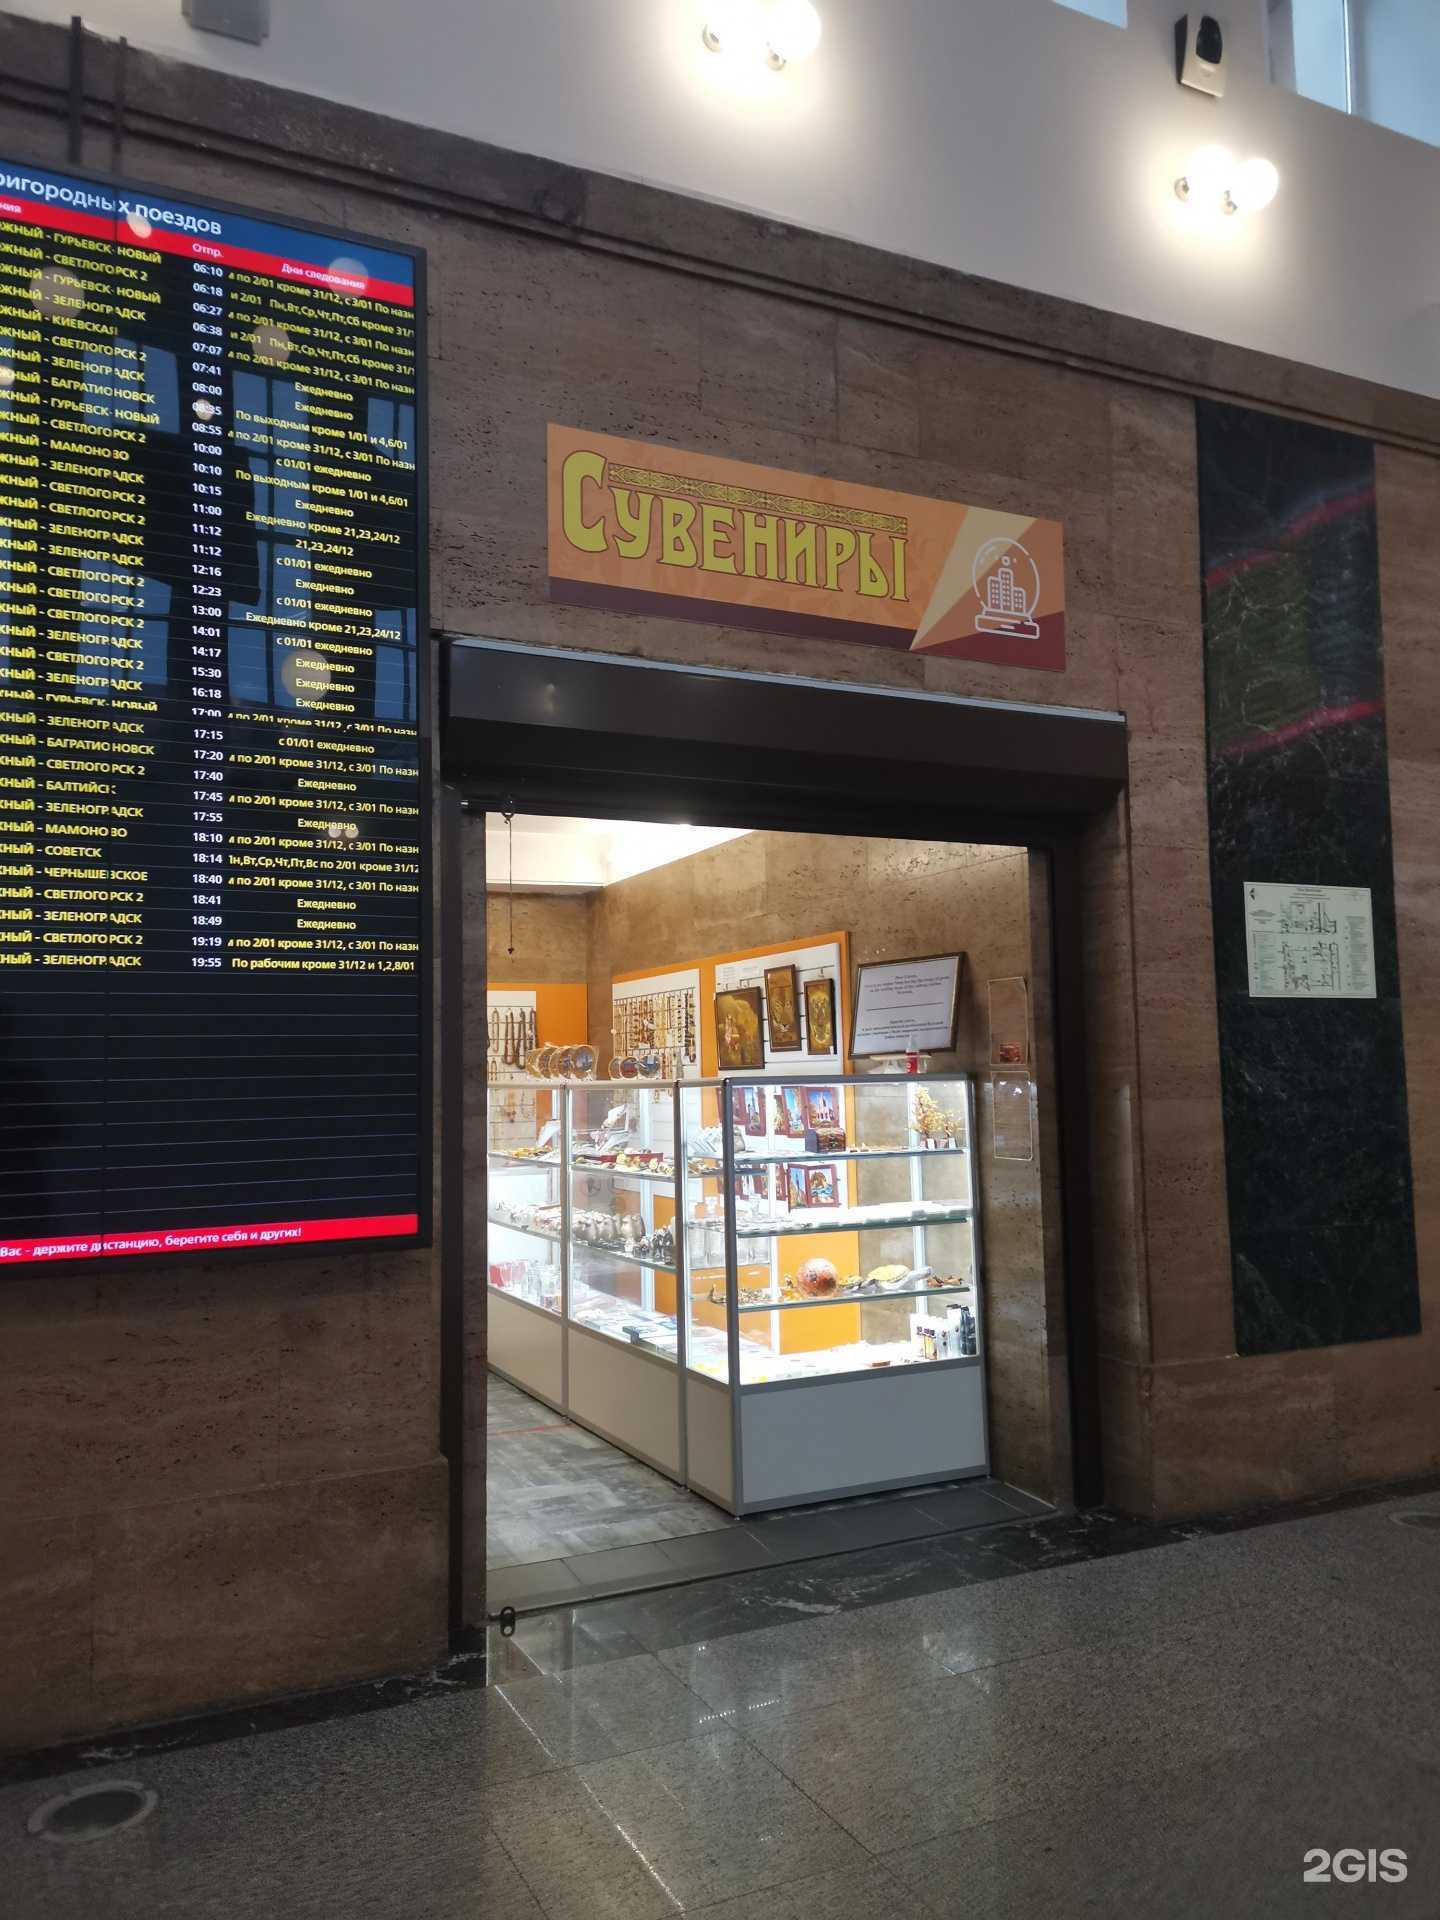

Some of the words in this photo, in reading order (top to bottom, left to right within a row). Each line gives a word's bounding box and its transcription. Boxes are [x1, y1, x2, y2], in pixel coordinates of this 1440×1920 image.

[135, 204, 222, 235] поездов
[192, 243, 224, 258] Отпр.
[53, 254, 138, 279] СВЕТЛОГОРСК
[193, 262, 223, 277] 06:10
[282, 264, 304, 276] Дни
[305, 268, 365, 289] следования
[192, 282, 223, 296] 06:18
[192, 302, 222, 316] 06:27
[192, 322, 222, 336] 06:38
[51, 335, 137, 360] СВЕТЛОГОРСК
[192, 342, 222, 355] 07:07
[192, 362, 221, 375] 07:41
[51, 376, 155, 404] БАГРАТИОНОВСК
[192, 382, 222, 396] 08:00
[295, 382, 353, 401] Ежедневно
[295, 401, 354, 421] Ежедневно
[50, 418, 136, 442] СВЕТЛОГОРСК
[191, 422, 222, 435] 08:55
[236, 410, 252, 421] По
[253, 414, 310, 432] выходным
[311, 426, 346, 438] кроме
[348, 430, 367, 442] 1/01
[378, 437, 407, 450] 4,6/01
[193, 442, 222, 456] 10:00
[252, 432, 273, 445] 2/01
[276, 439, 311, 452] кроме
[312, 443, 344, 459] 31/12,
[352, 450, 372, 462] 3/01
[192, 462, 222, 476] 10:10
[283, 458, 311, 471] 01/01
[313, 465, 372, 482] ежедневно
[49, 481, 136, 503] СВЕТЛОГОРСК
[192, 482, 222, 496] 10:15
[235, 469, 251, 480] По
[253, 474, 310, 490] выходным
[312, 484, 346, 496] кроме
[348, 489, 368, 500] 1/01
[379, 494, 408, 507] 4,6/01
[48, 502, 135, 523] СВЕТЛОГОРСК
[192, 503, 222, 516] 11:00
[295, 499, 354, 517] Ежедневно
[192, 523, 222, 536] 11:12
[246, 511, 306, 529] Ежедневно
[308, 523, 342, 535] кроме
[344, 527, 400, 544] 21,23,24/12
[562, 450, 909, 602] СУВЕНИРЫ
[192, 544, 222, 556] 11:12
[295, 539, 353, 556] 21,23,24/12
[192, 564, 222, 576] 12:16
[283, 557, 311, 569] 01/01
[314, 563, 372, 578] ежедневно
[47, 566, 135, 586] СВЕТЛОГОРСК
[192, 584, 221, 597] 12:23
[295, 578, 354, 595] Ежедневно
[47, 587, 135, 607] СВЕТЛОГОРСК
[192, 605, 222, 617] 13:00
[284, 597, 311, 609] 01/01
[314, 602, 373, 617] ежедневно
[46, 608, 135, 627] СВЕТЛОГОРСК
[192, 625, 220, 637] 14:01
[245, 611, 306, 628] Ежедневно
[308, 621, 343, 632] кроме
[344, 624, 400, 640] 21,23,24/12
[192, 646, 221, 657] 14:17
[284, 636, 312, 648] 01/01
[314, 642, 373, 656] ежедневно
[46, 651, 134, 669] СВЕТЛОГОРСК
[296, 658, 354, 673] Ежедневно
[192, 666, 221, 678] 15:30
[192, 687, 222, 698] 16:18
[296, 678, 354, 693] Ежедневно
[296, 698, 354, 712] Ежедневно
[194, 729, 223, 740] 17:15
[46, 737, 154, 755] БАГРАТИОНОВСК
[286, 737, 314, 748] 01/01
[316, 741, 375, 753] ежедневно
[193, 749, 223, 760] 17:20
[46, 759, 135, 774] СВЕТЛОГОРСК
[237, 754, 252, 763] по
[254, 754, 276, 765] 2/01
[279, 758, 314, 768] кроме
[316, 759, 346, 772] 31/12,
[355, 763, 376, 773] 3/01
[379, 765, 393, 774] По
[193, 770, 223, 781] 17:40
[298, 778, 357, 791] Ежедневно
[193, 790, 223, 802] 17:45
[237, 795, 252, 804] по
[254, 795, 275, 805] 2/01
[278, 798, 314, 808] кроме
[316, 799, 346, 811] 31/12,
[355, 802, 376, 812] 3/01
[379, 804, 394, 813] По
[193, 811, 223, 822] 17:55
[297, 818, 357, 832] Ежедневно
[193, 832, 223, 843] 18:10
[44, 845, 102, 857] СОВЕТСК
[192, 853, 223, 863] 18:14
[320, 861, 334, 869] по
[336, 860, 356, 870] 2/01
[359, 863, 392, 872] кроме
[192, 874, 222, 884] 18:40
[44, 889, 134, 902] СВЕТЛОГОРСК
[192, 894, 221, 904] 18:41
[297, 898, 356, 910] Ежедневно
[192, 915, 222, 926] 18:49
[297, 918, 356, 930] Ежедневно
[43, 932, 133, 944] СВЕТЛОГОРСК
[192, 936, 222, 946] 19:19
[236, 939, 251, 947] по
[253, 938, 275, 948] 2/01
[278, 940, 314, 950] кроме
[315, 939, 346, 950] 31/12,
[355, 940, 376, 950] 3/01
[379, 941, 393, 950] По
[192, 957, 222, 967] 19:55
[232, 958, 248, 968] По
[250, 958, 300, 970] рабочим
[302, 961, 336, 971] кроме
[338, 960, 366, 970] 31/12
[377, 961, 414, 971] 1,2,8/01
[0, 1247, 22, 1257] Вас
[33, 1242, 88, 1256] держите
[90, 1238, 162, 1253] дистанцию,
[166, 1234, 219, 1247] берегите
[222, 1230, 247, 1241] себя
[260, 1228, 302, 1241] других!
